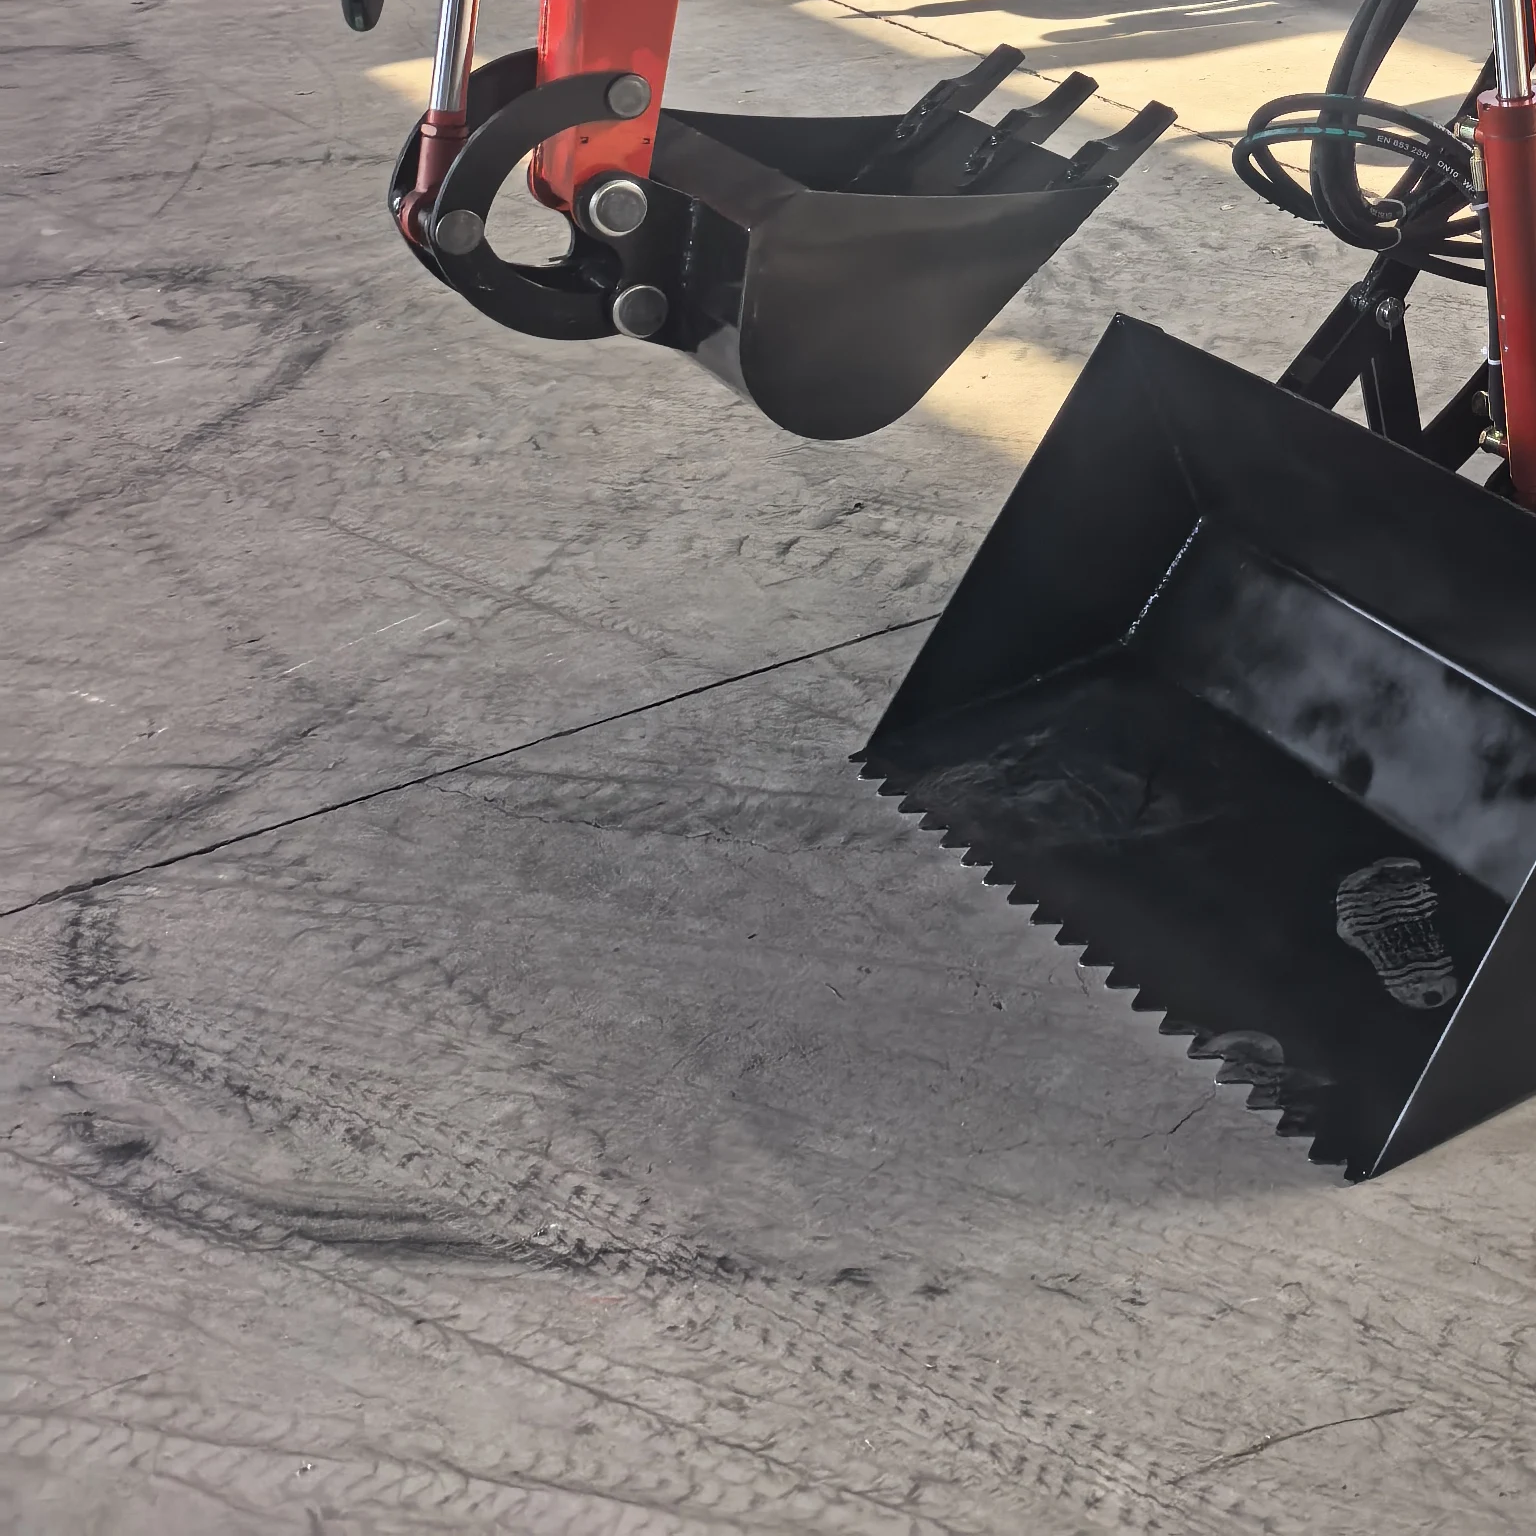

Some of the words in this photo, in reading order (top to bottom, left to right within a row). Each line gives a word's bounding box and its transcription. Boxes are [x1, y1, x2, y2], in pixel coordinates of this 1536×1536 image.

[1376, 135, 1391, 144] EN
[1393, 139, 1410, 151] 853
[1411, 146, 1430, 159] 2SN
[1437, 160, 1459, 178] DN10
